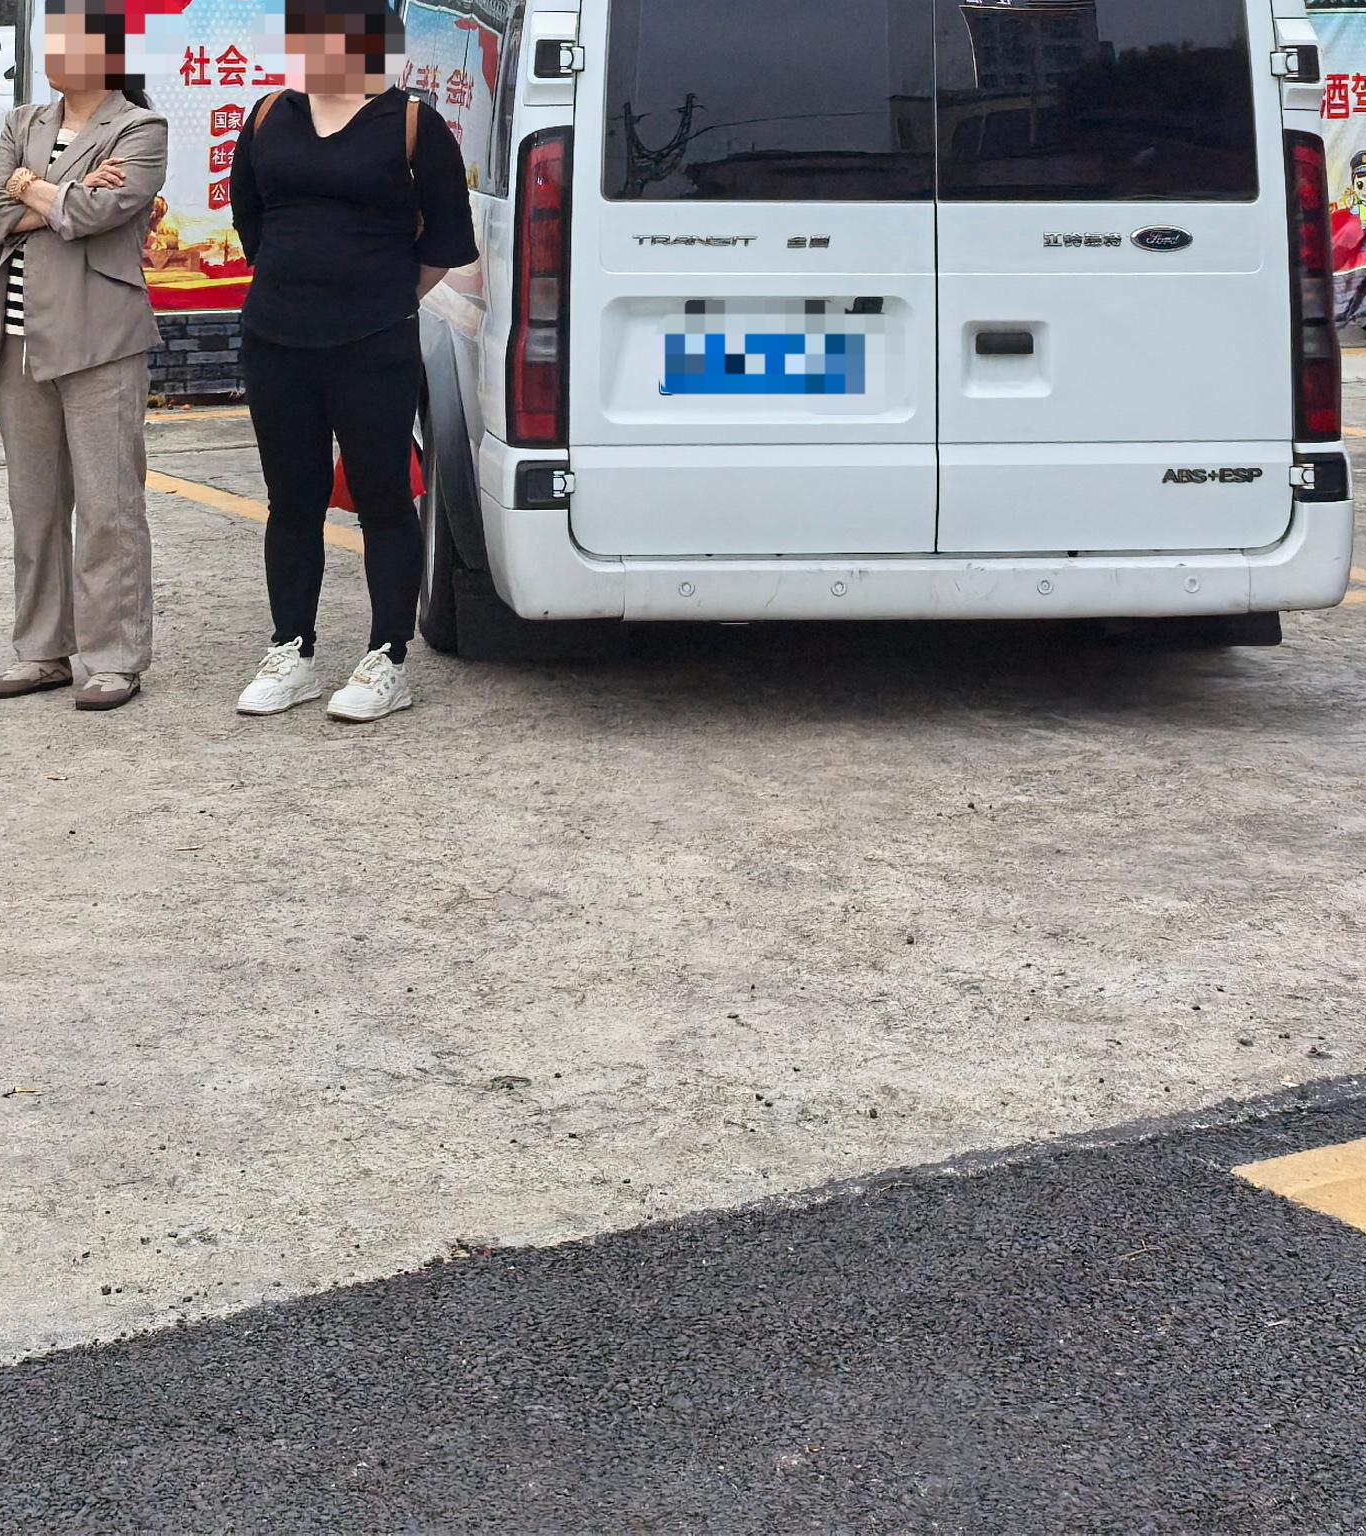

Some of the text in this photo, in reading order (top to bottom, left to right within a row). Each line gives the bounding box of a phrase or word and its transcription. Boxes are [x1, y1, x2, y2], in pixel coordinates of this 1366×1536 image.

[180, 45, 285, 86] 社会
[212, 184, 231, 202] 公
[1162, 467, 1263, 483] ABS+ESP
